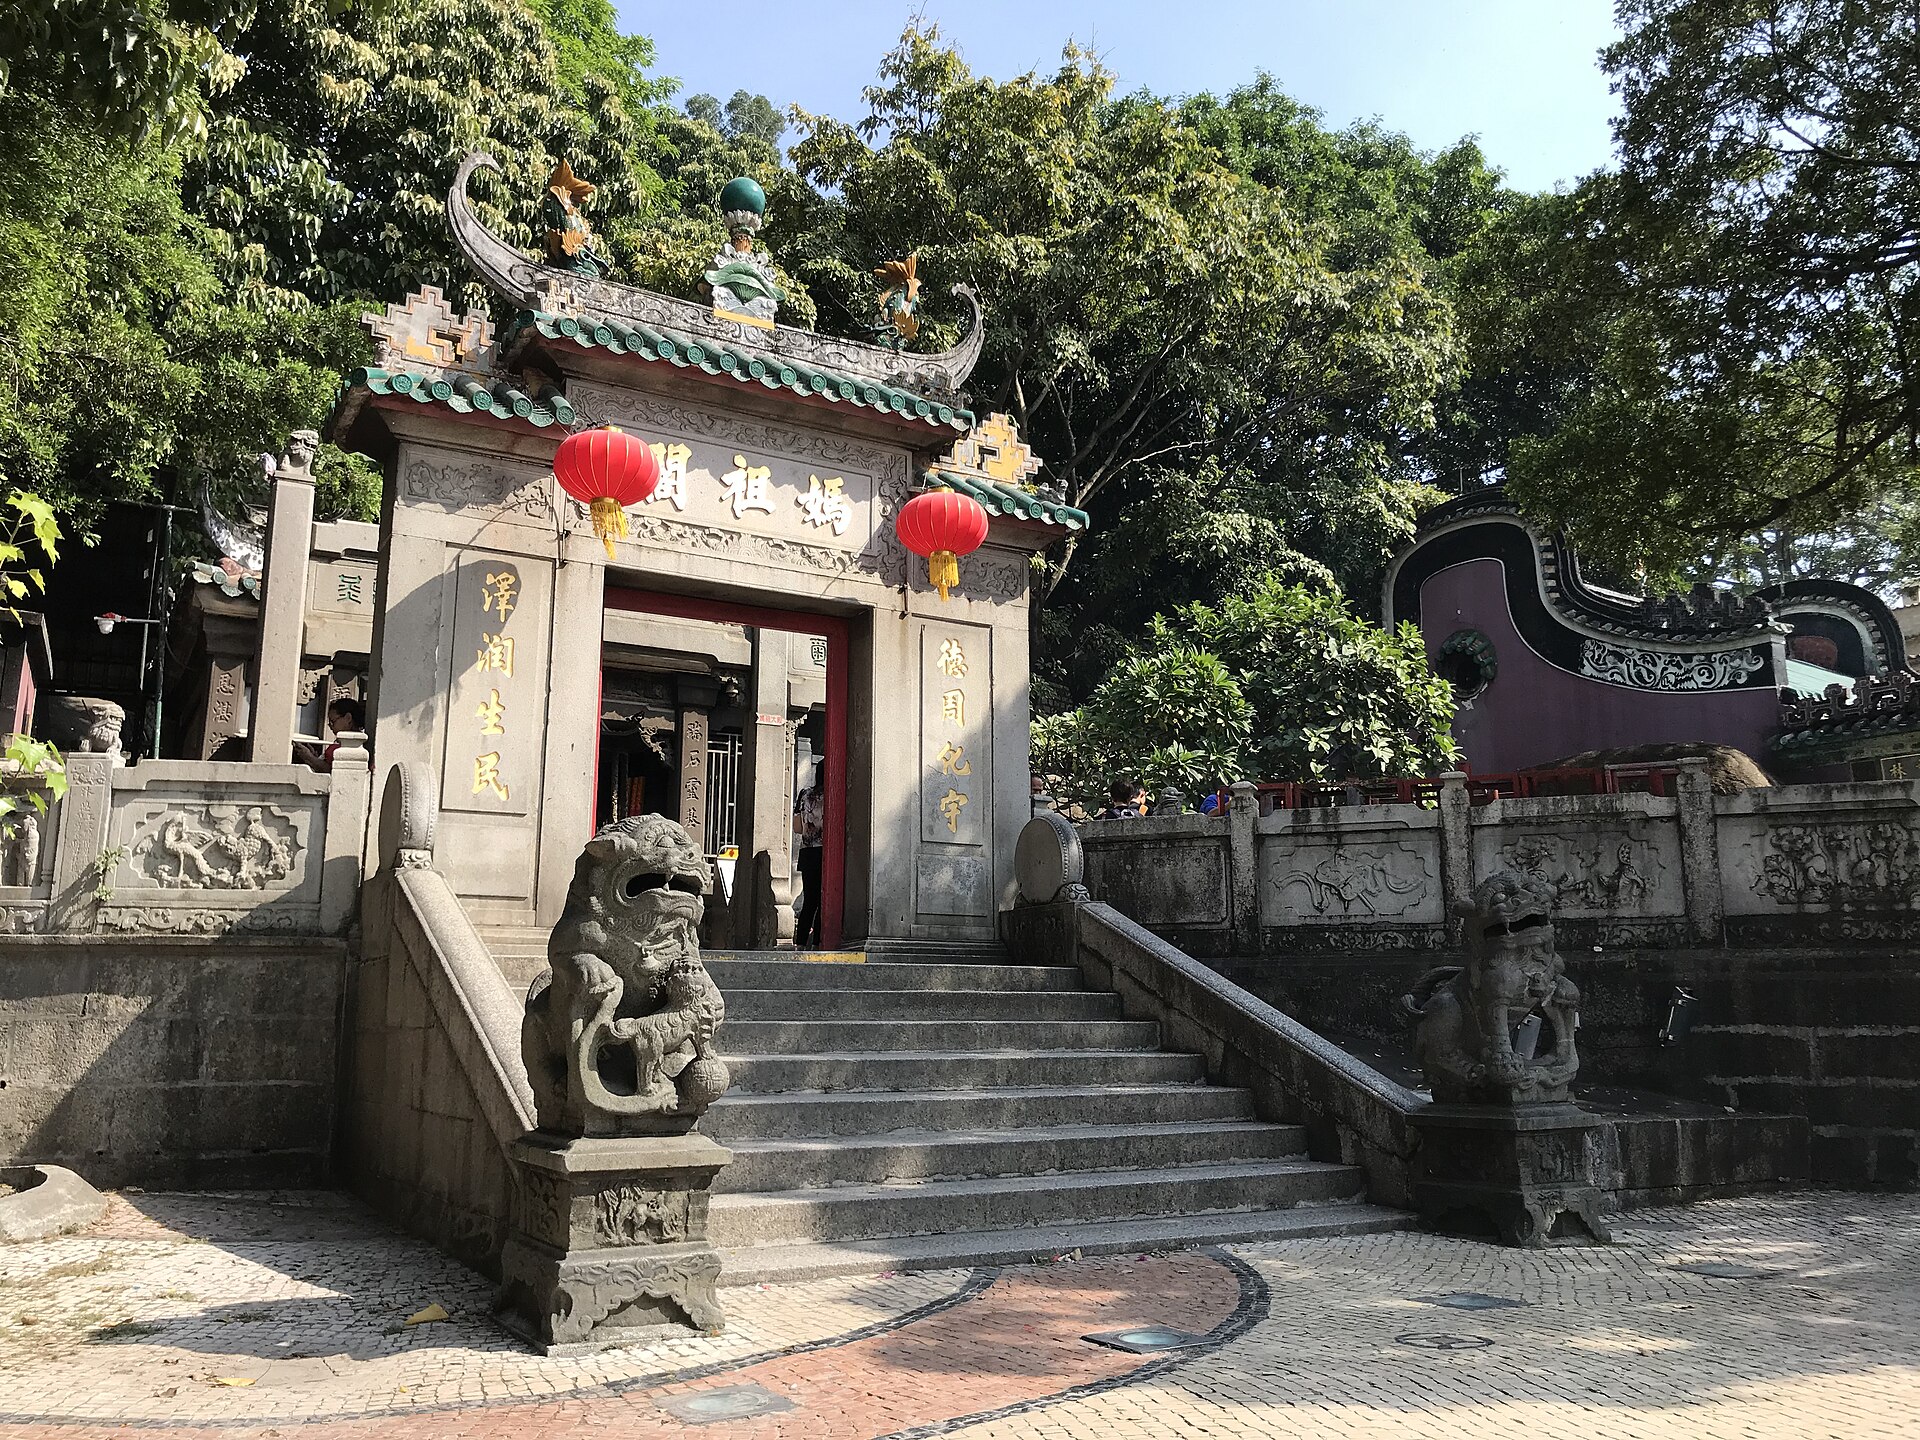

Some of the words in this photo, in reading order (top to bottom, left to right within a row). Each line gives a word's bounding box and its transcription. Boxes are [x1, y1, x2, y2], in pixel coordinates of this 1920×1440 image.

[644, 442, 852, 537] 媽祖閣
[472, 571, 518, 801] 澤潤生民
[936, 637, 972, 834] 德周化宇
